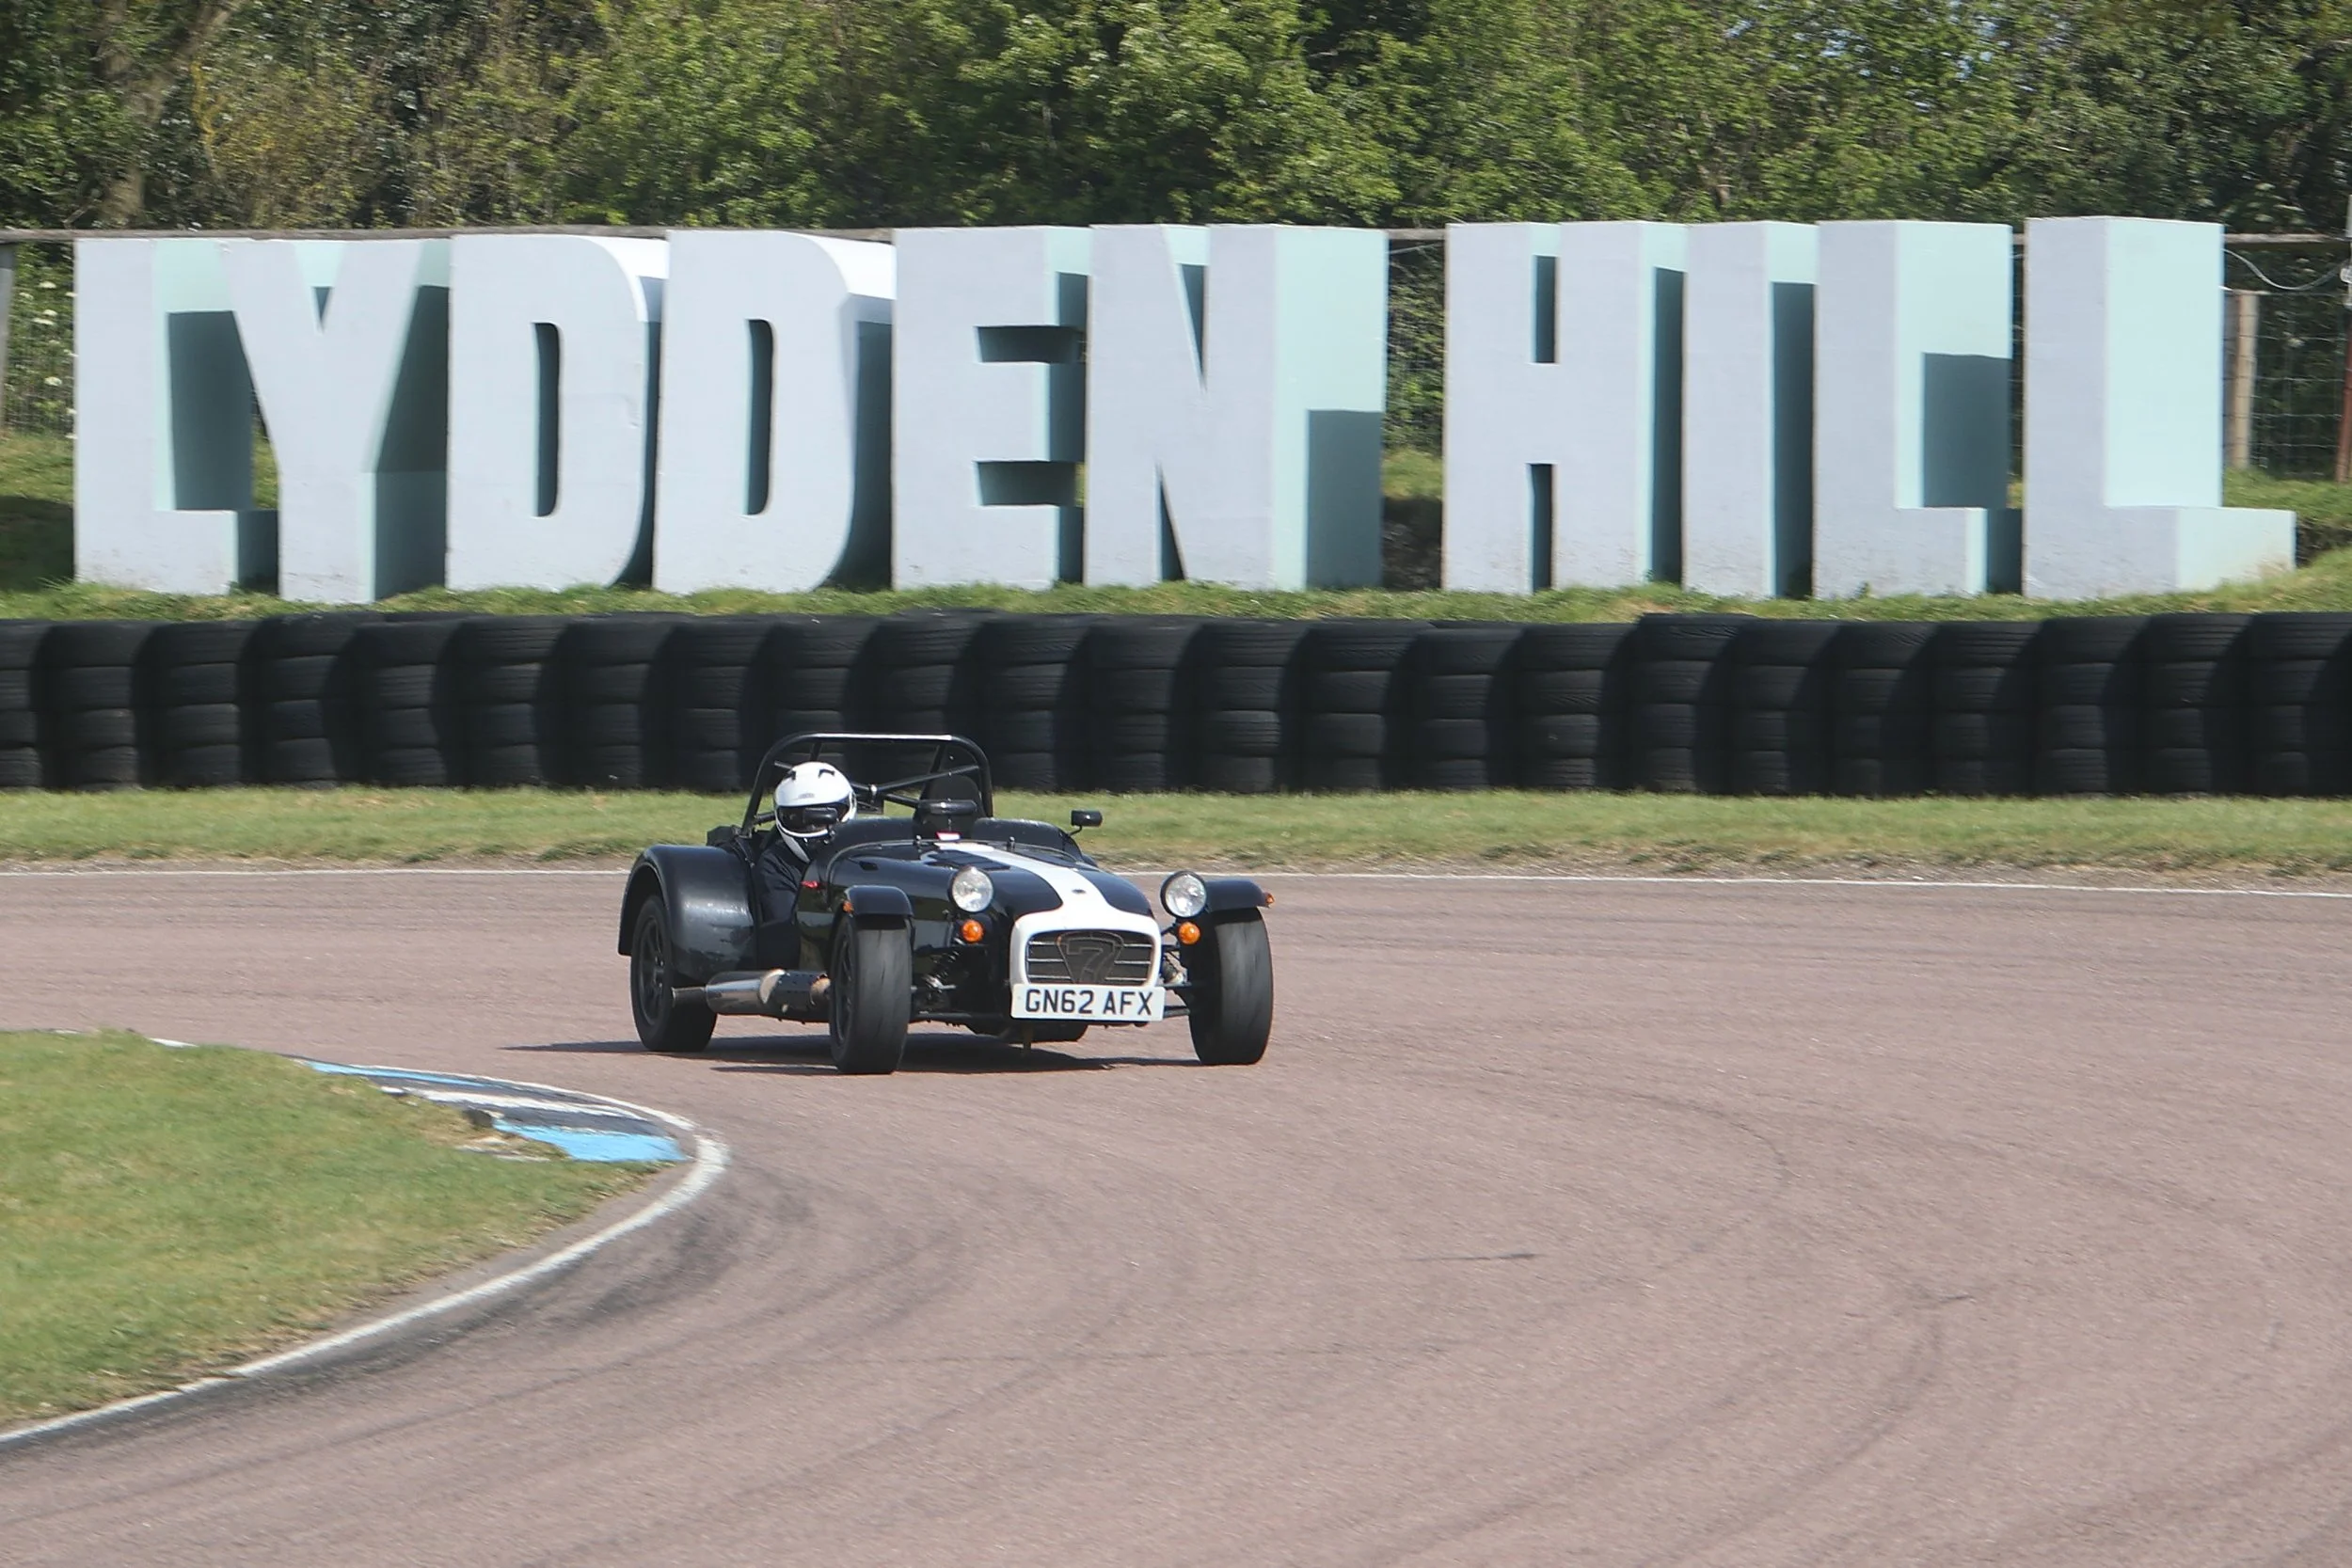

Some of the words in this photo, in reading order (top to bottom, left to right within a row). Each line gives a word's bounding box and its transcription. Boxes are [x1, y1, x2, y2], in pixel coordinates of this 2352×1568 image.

[73, 224, 1308, 604] LYDDEN
[1441, 216, 2181, 600] HILL
[1025, 989, 1095, 1015] GN62
[1103, 990, 1153, 1016] AFX
